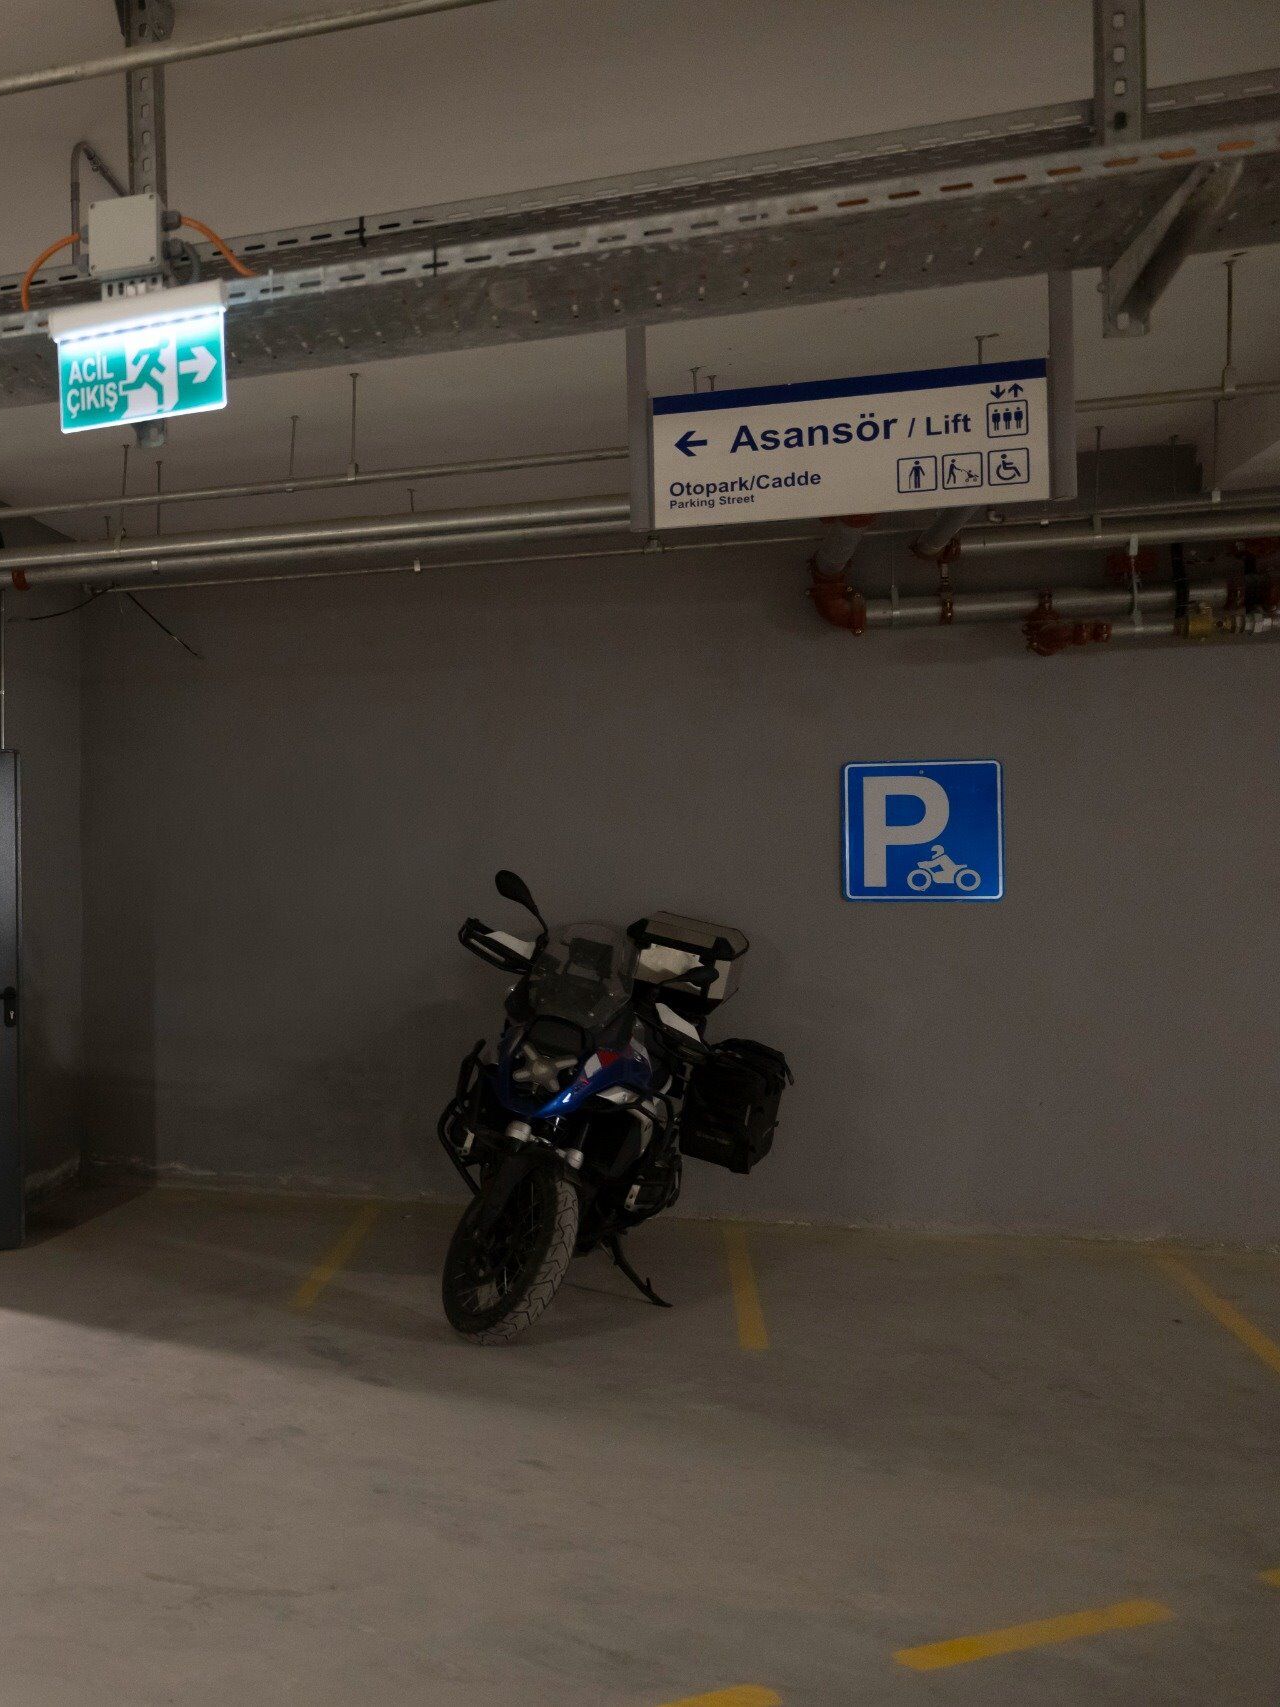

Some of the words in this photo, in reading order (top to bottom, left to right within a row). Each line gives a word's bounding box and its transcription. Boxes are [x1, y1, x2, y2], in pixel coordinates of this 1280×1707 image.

[67, 382, 118, 419] ÇIKIŞ
[730, 412, 898, 453] Asansör
[908, 417, 916, 438] /
[925, 413, 972, 436] Lift
[669, 471, 822, 499] Otopark/Cadde
[669, 497, 715, 510] Parking
[719, 494, 755, 506] Street
[863, 776, 950, 887] P
